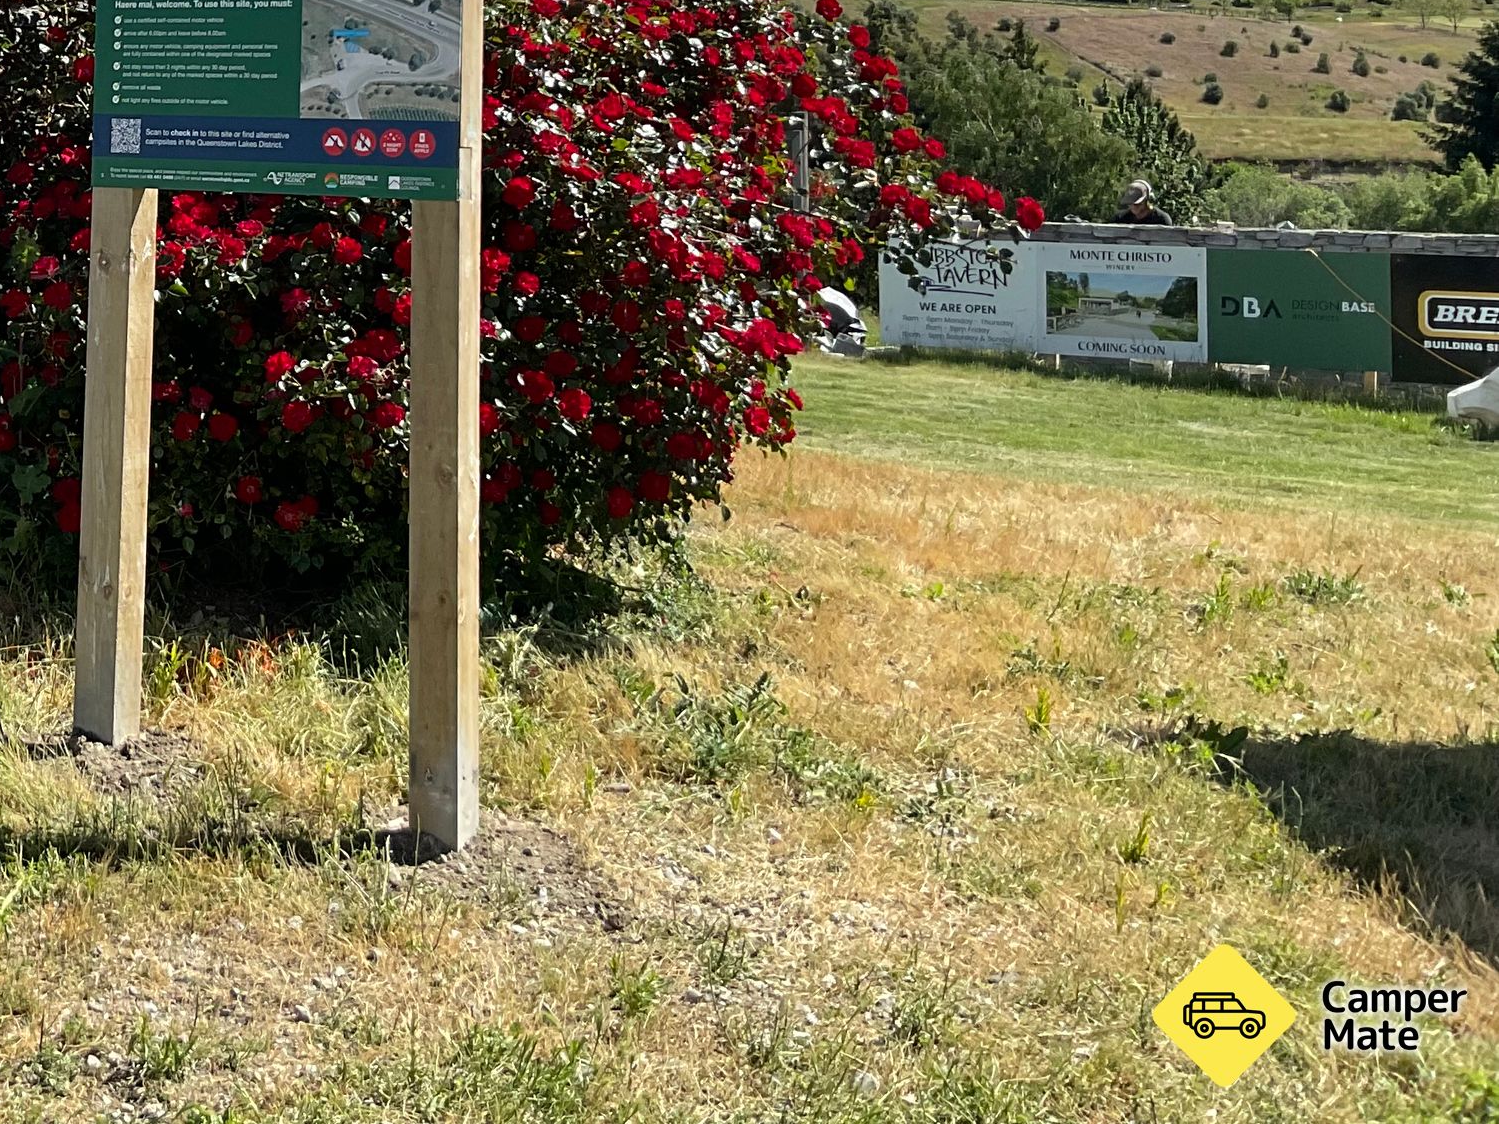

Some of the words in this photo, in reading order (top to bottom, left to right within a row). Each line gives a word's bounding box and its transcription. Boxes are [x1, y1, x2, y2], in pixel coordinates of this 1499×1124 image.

[115, 0, 137, 9] Haere
[138, 0, 154, 9] mai,
[156, 0, 192, 8] welcome.
[193, 0, 202, 8] To
[220, 0, 234, 8] this
[236, 0, 252, 9] site,
[254, 1, 268, 9] you
[270, 0, 293, 7] must:
[145, 128, 161, 136] Scan
[171, 129, 191, 137] check
[192, 129, 199, 137] in
[208, 130, 220, 138] this
[221, 130, 233, 138] site
[255, 131, 290, 139] alternative
[145, 138, 177, 147] campsites
[184, 139, 195, 147] the
[196, 139, 237, 148] Queenstown
[238, 140, 257, 148] Lakes
[258, 141, 284, 149] District.
[340, 174, 378, 182] RESPONSIBLE
[1070, 249, 1115, 261] MONTE
[1117, 250, 1172, 263] CHRISTO
[932, 264, 1007, 289] TAVERN
[920, 302, 936, 312] WE
[940, 303, 962, 313] ARE
[964, 304, 996, 314] OPEN
[1222, 296, 1282, 319] DBA
[1433, 305, 1499, 324] BRE
[1078, 341, 1127, 354] COMING
[1130, 343, 1166, 355] SOON
[1423, 340, 1482, 351] BUILDING
